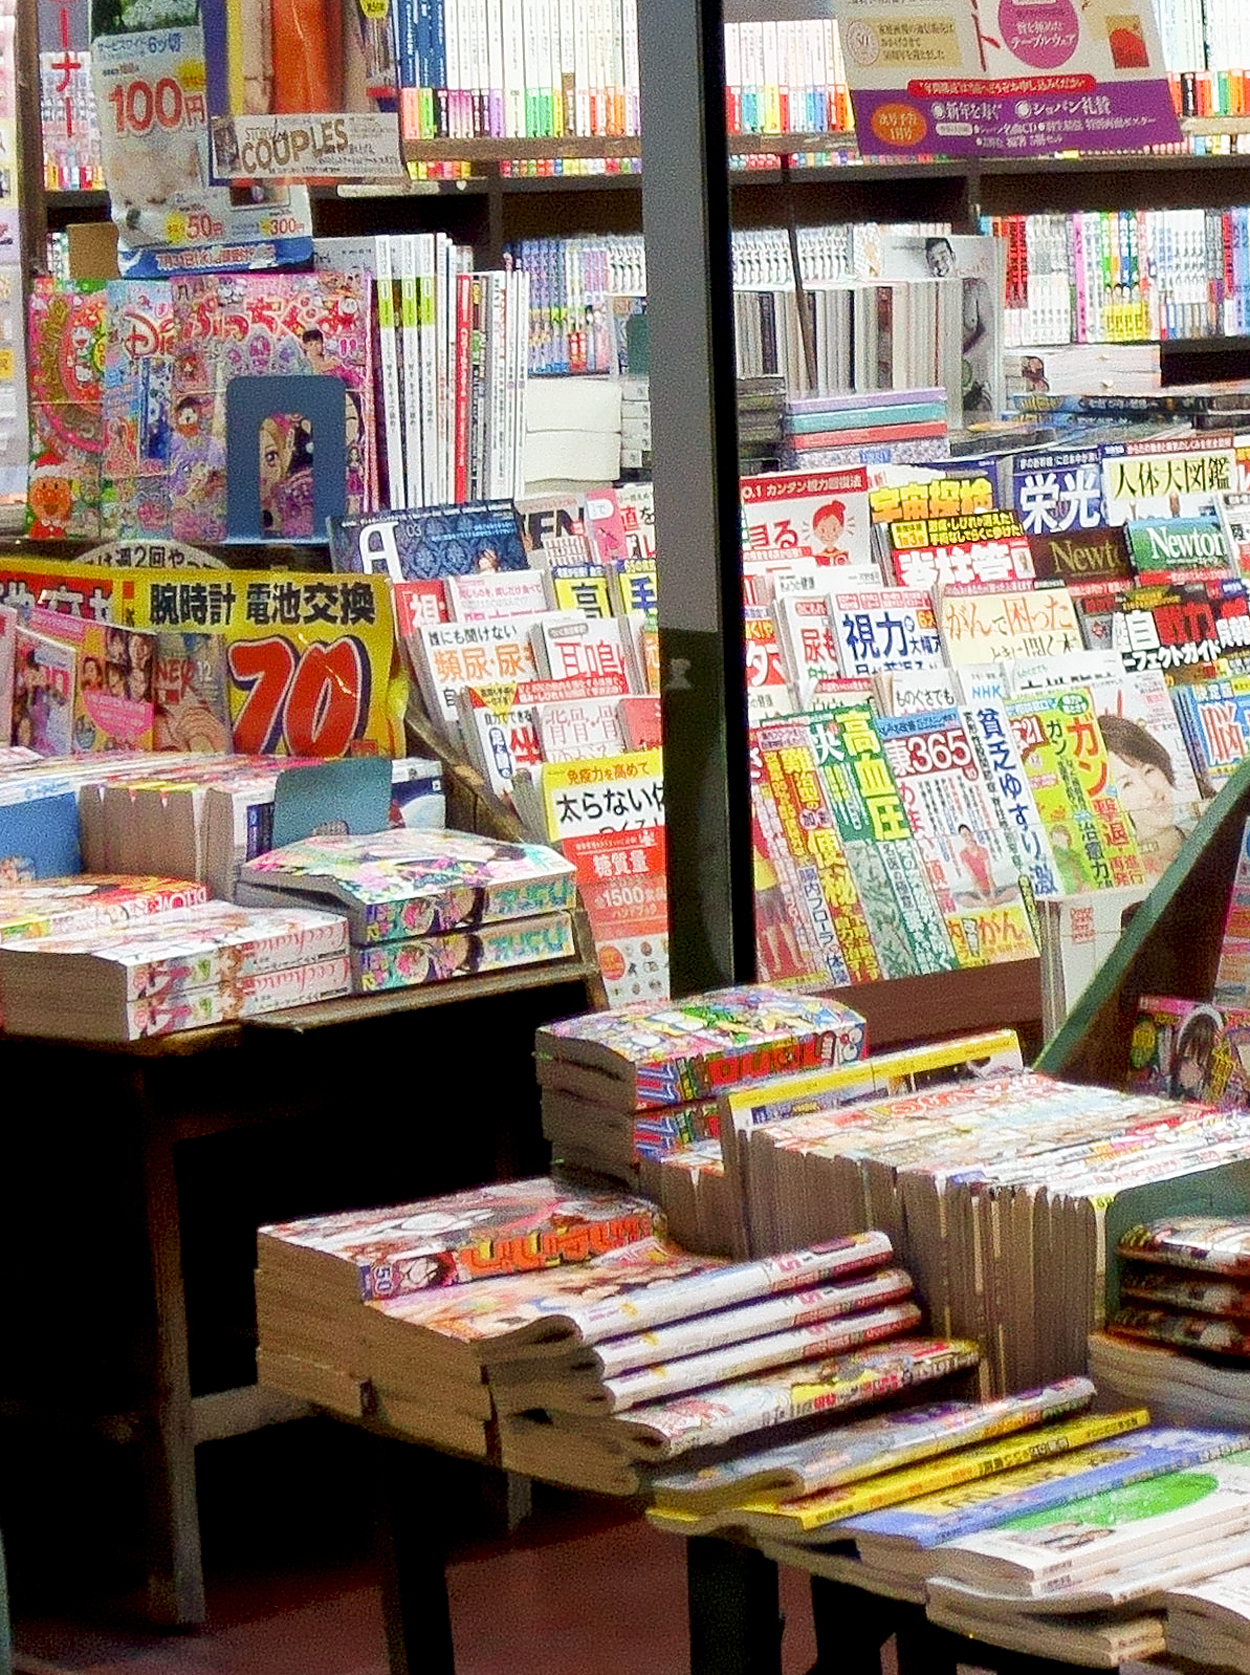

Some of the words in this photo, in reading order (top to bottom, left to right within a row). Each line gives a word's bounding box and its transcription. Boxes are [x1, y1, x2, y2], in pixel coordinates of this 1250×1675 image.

[241, 118, 350, 174] COUPLES
[1114, 456, 1231, 499] 人体大図鑑
[1020, 472, 1101, 535] 栄光
[1146, 526, 1228, 562] Newton
[149, 582, 236, 626] 腕時計
[246, 581, 376, 627] 電池交換
[842, 611, 912, 662] 視力
[971, 684, 1000, 700] NHK
[566, 760, 650, 785] 免疫力を高めて
[834, 709, 912, 841] 高血圧
[1066, 714, 1109, 798] ガン
